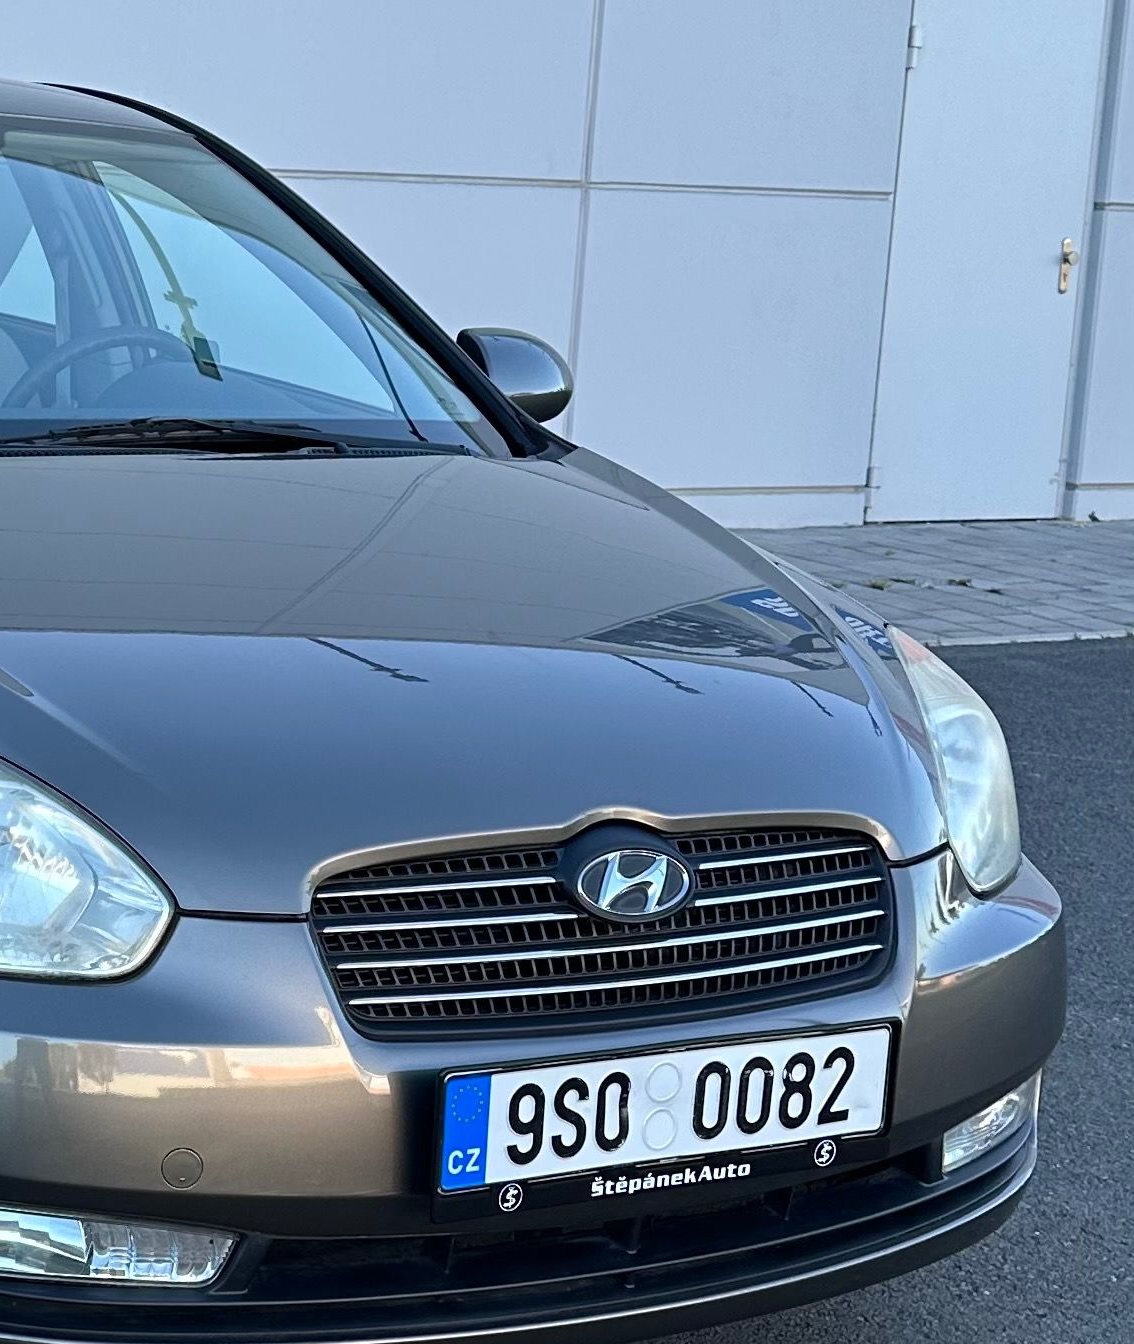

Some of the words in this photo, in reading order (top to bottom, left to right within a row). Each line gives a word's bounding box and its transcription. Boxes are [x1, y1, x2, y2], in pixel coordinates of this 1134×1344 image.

[692, 1046, 855, 1140] 0082
[447, 1147, 481, 1175] CZ
[590, 1163, 751, 1197] ŠtěpánekAuto
